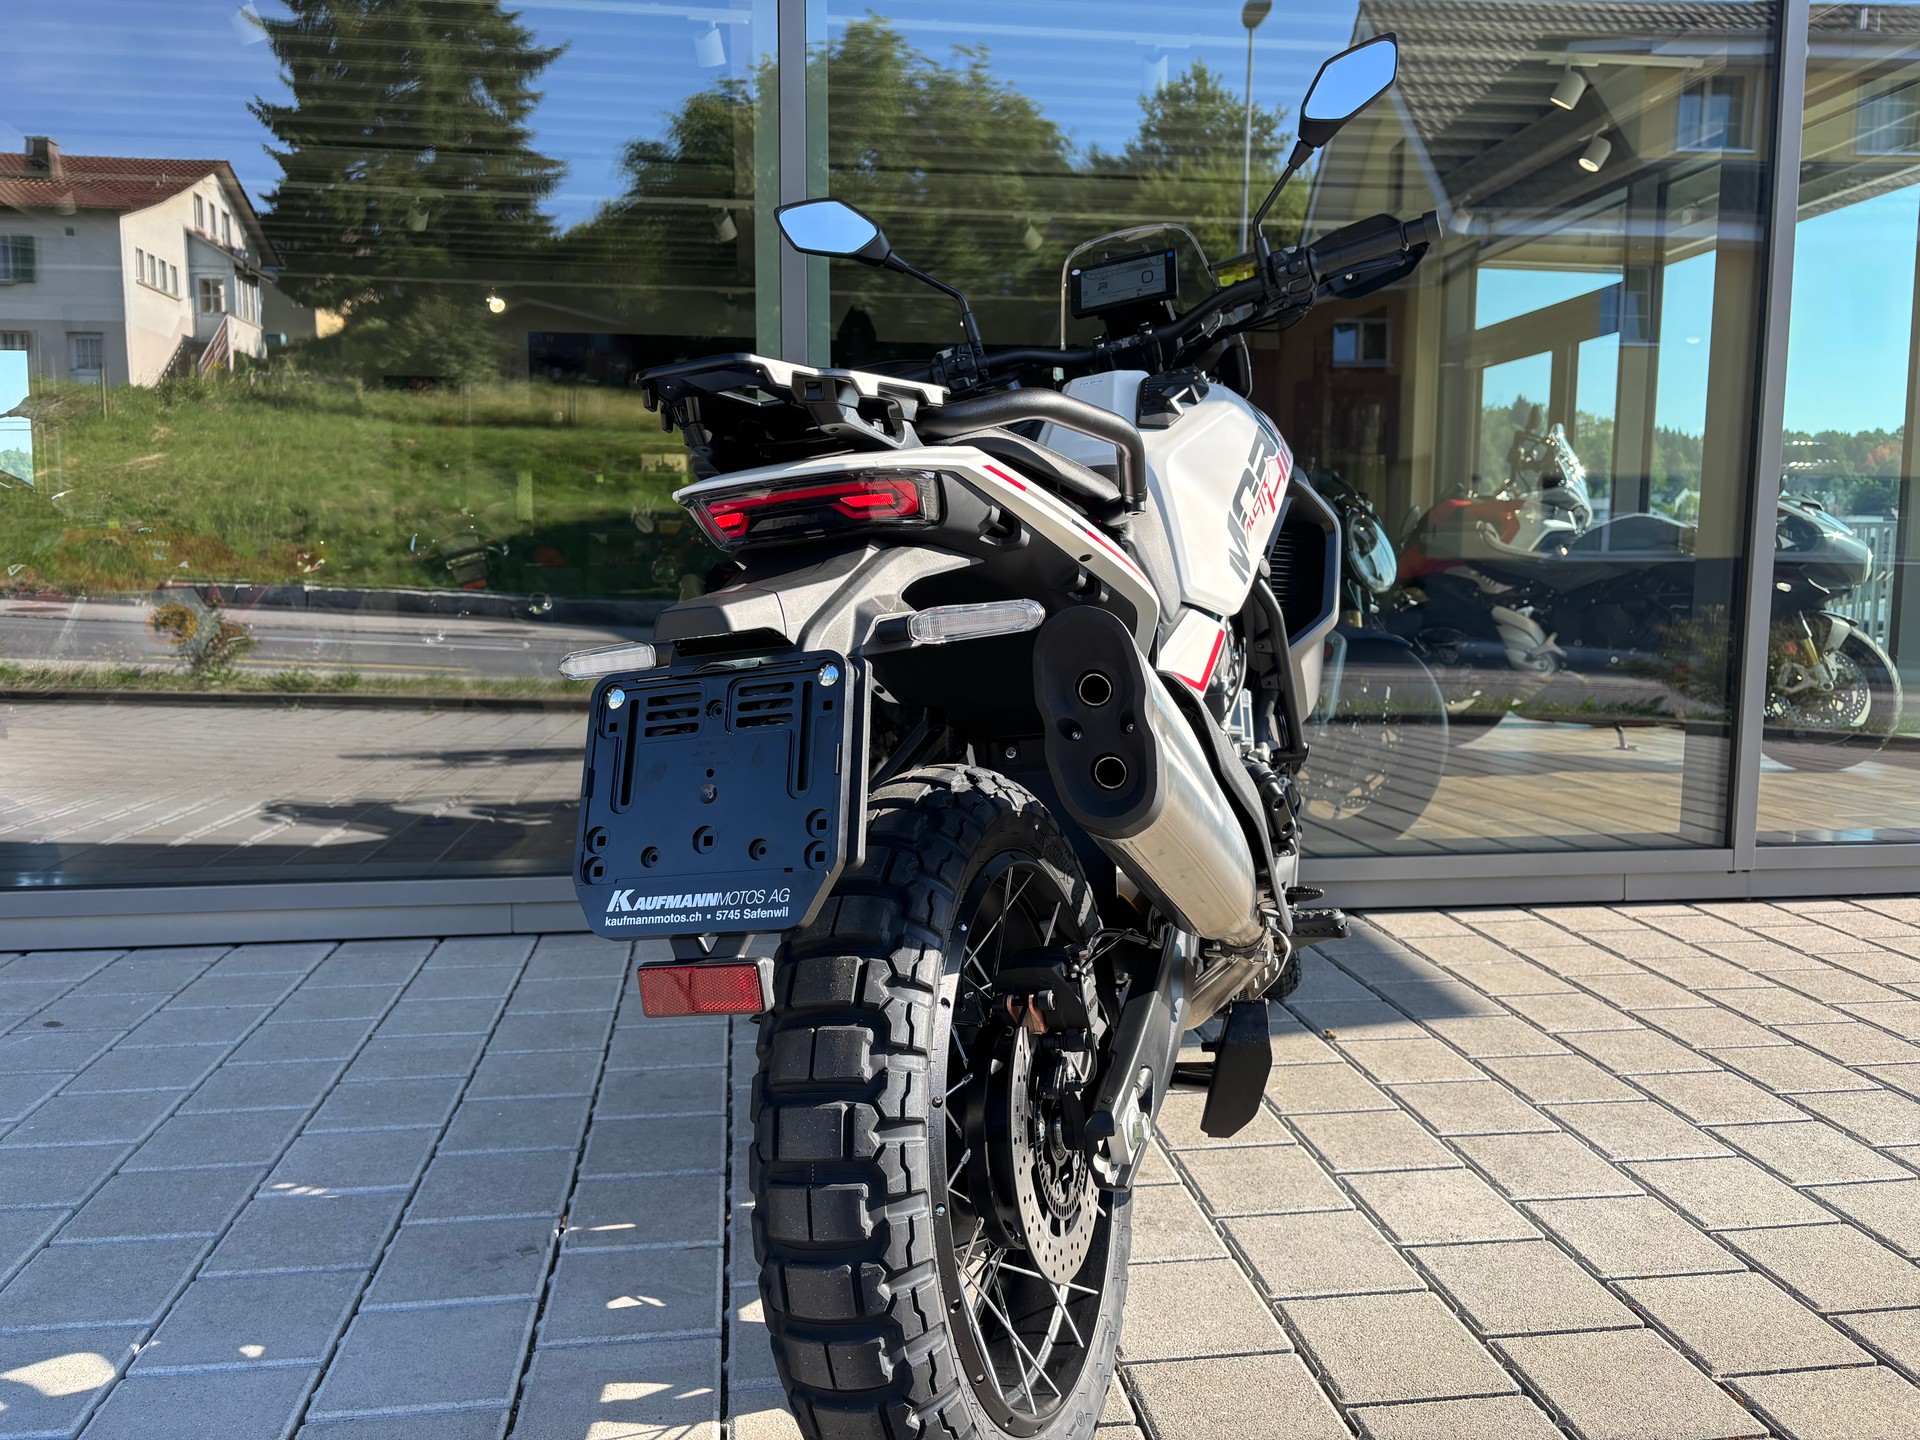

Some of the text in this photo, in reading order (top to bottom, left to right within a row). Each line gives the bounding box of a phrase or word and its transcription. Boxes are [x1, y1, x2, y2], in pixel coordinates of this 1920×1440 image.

[768, 888, 791, 903] AG
[605, 907, 789, 927] kaufmannmotos.ch 5745 Safenwil
